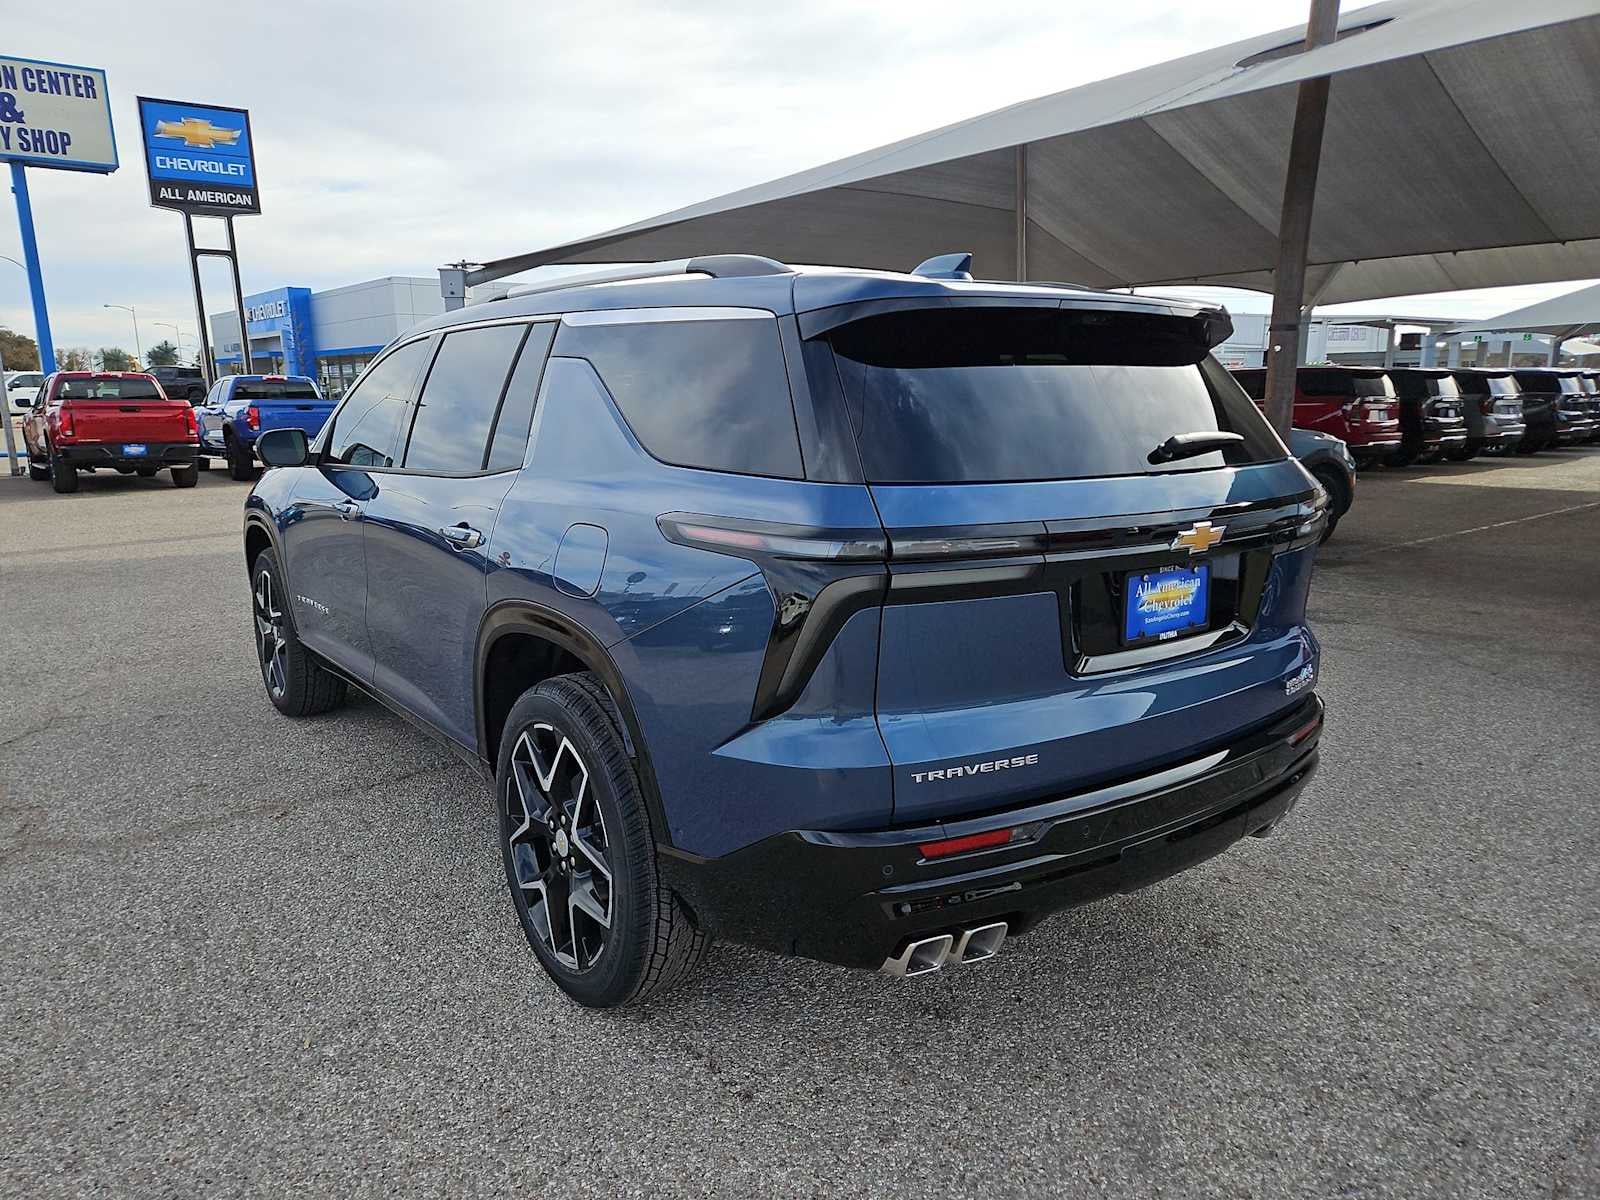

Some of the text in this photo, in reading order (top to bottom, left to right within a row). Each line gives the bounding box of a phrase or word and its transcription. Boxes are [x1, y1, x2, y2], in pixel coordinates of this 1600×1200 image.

[0, 65, 97, 99] N CENTER
[0, 91, 26, 124] &
[16, 127, 72, 155] SHOP
[155, 156, 246, 176] CHEVROLET
[160, 187, 253, 205] ALL AMERICAN
[1135, 577, 1201, 598] All American
[1144, 594, 1193, 613] Chevrolet
[910, 753, 1039, 784] TRAVERSE
